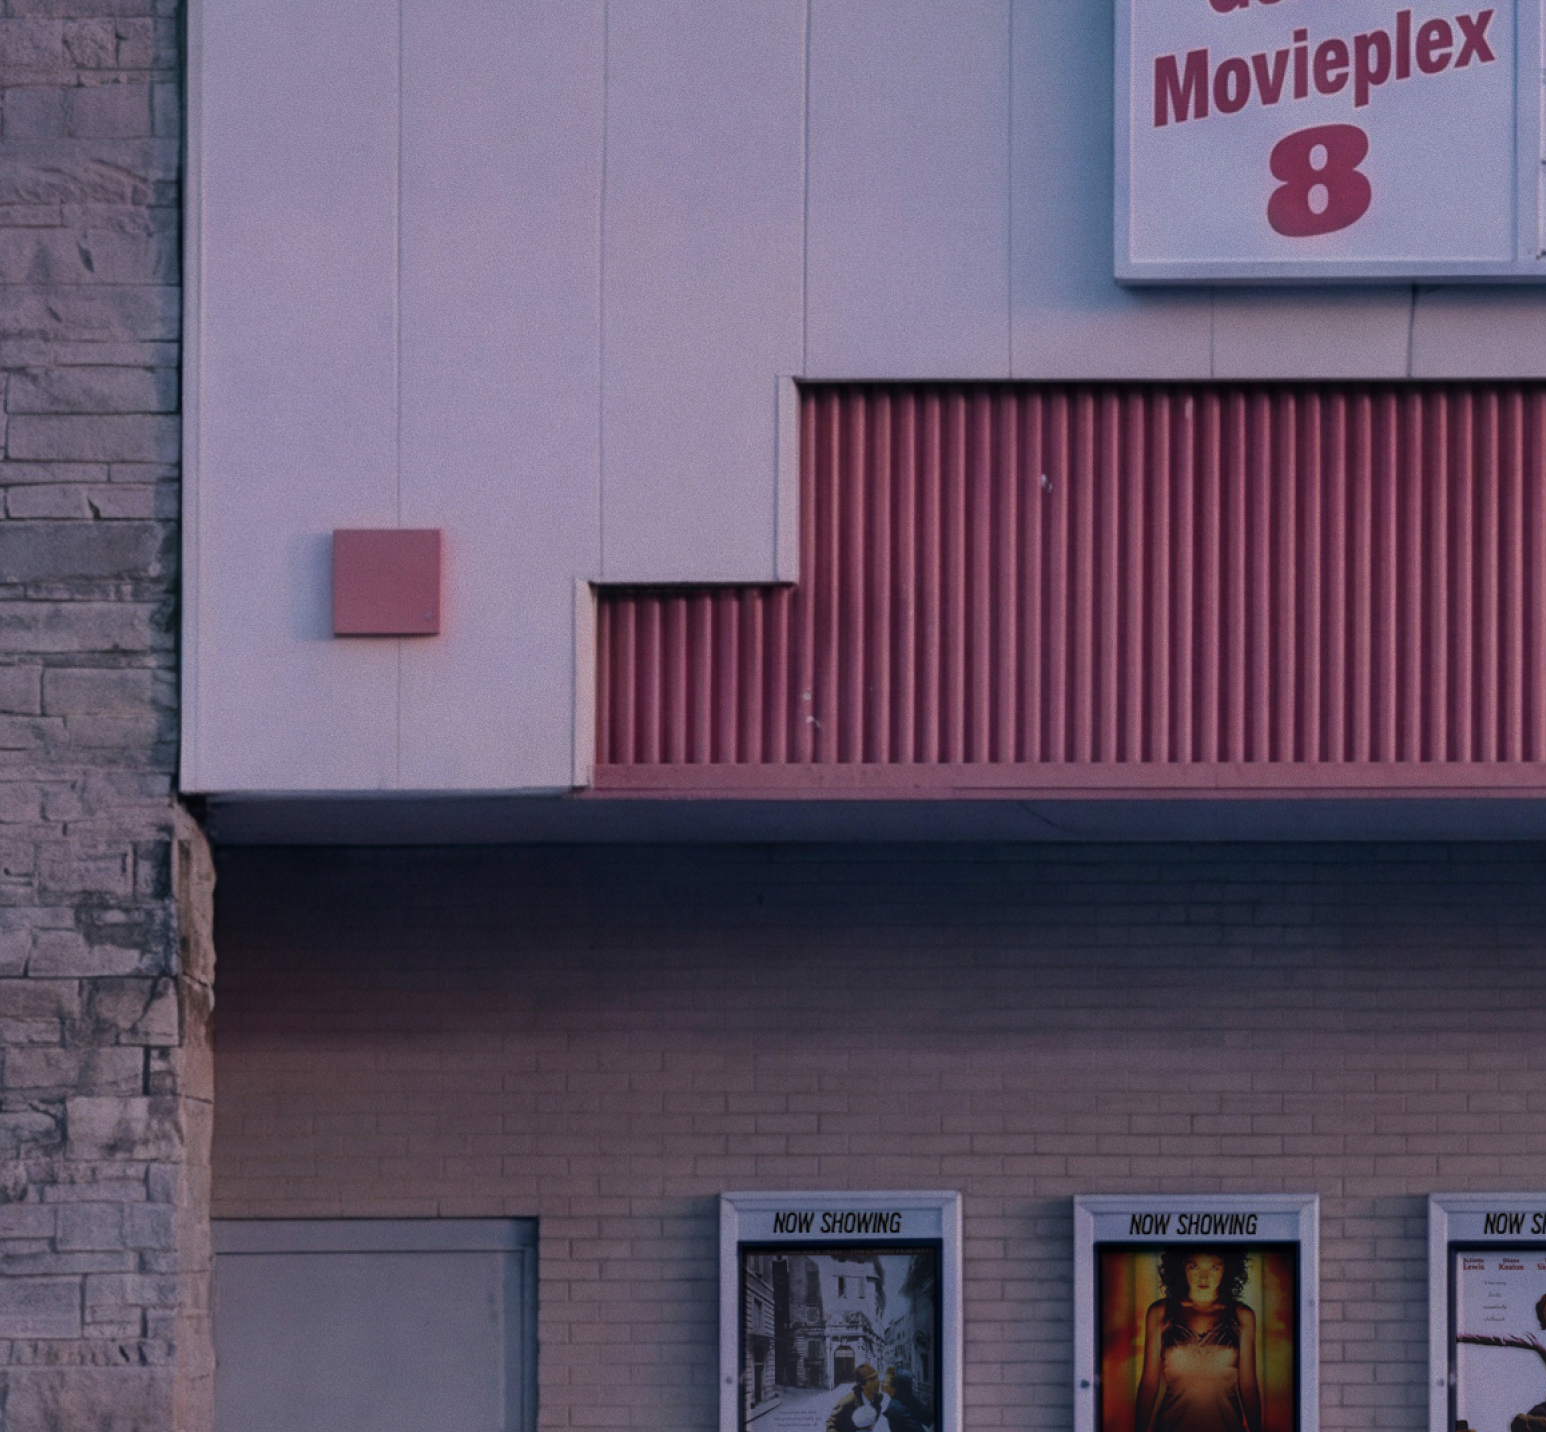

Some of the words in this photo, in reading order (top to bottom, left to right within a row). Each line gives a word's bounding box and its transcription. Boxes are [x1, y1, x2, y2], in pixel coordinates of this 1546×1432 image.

[1152, 8, 1496, 129] Movieplex
[1266, 123, 1372, 238] 8
[773, 1211, 815, 1233] NOW
[820, 1211, 903, 1233] SHOWING
[1129, 1213, 1171, 1235] NOW
[1176, 1213, 1258, 1235] SHOWING
[1484, 1212, 1526, 1234] NOW
